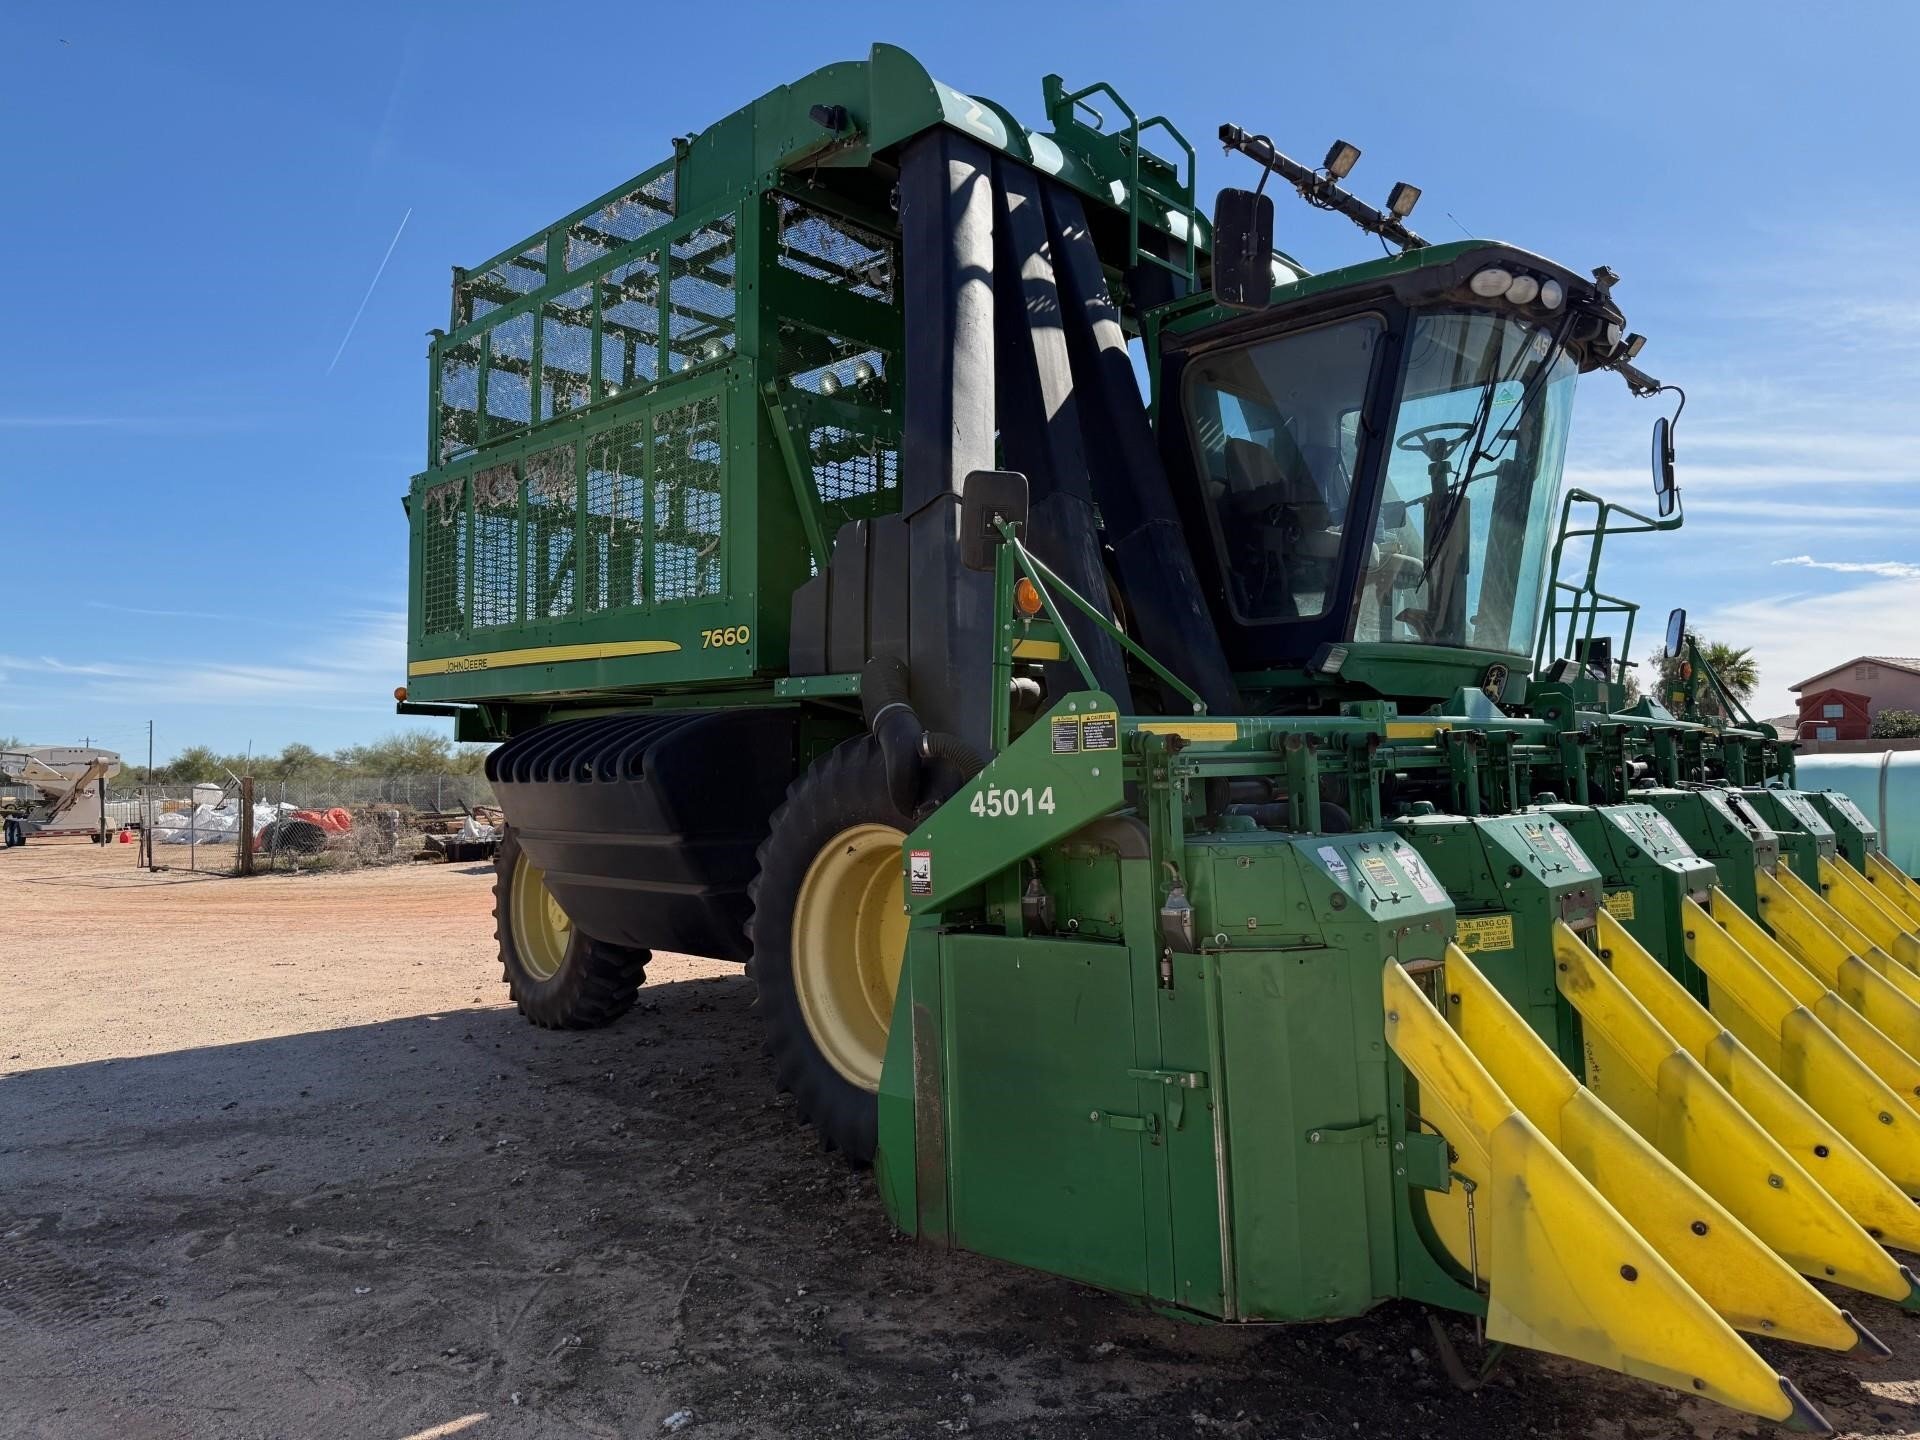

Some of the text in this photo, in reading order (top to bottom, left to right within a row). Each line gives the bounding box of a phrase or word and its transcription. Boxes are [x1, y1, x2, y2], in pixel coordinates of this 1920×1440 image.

[701, 625, 750, 649] 7660
[445, 658, 488, 672] JOHN DEERE
[970, 786, 1056, 817] 45014
[1476, 919, 1495, 928] KING
